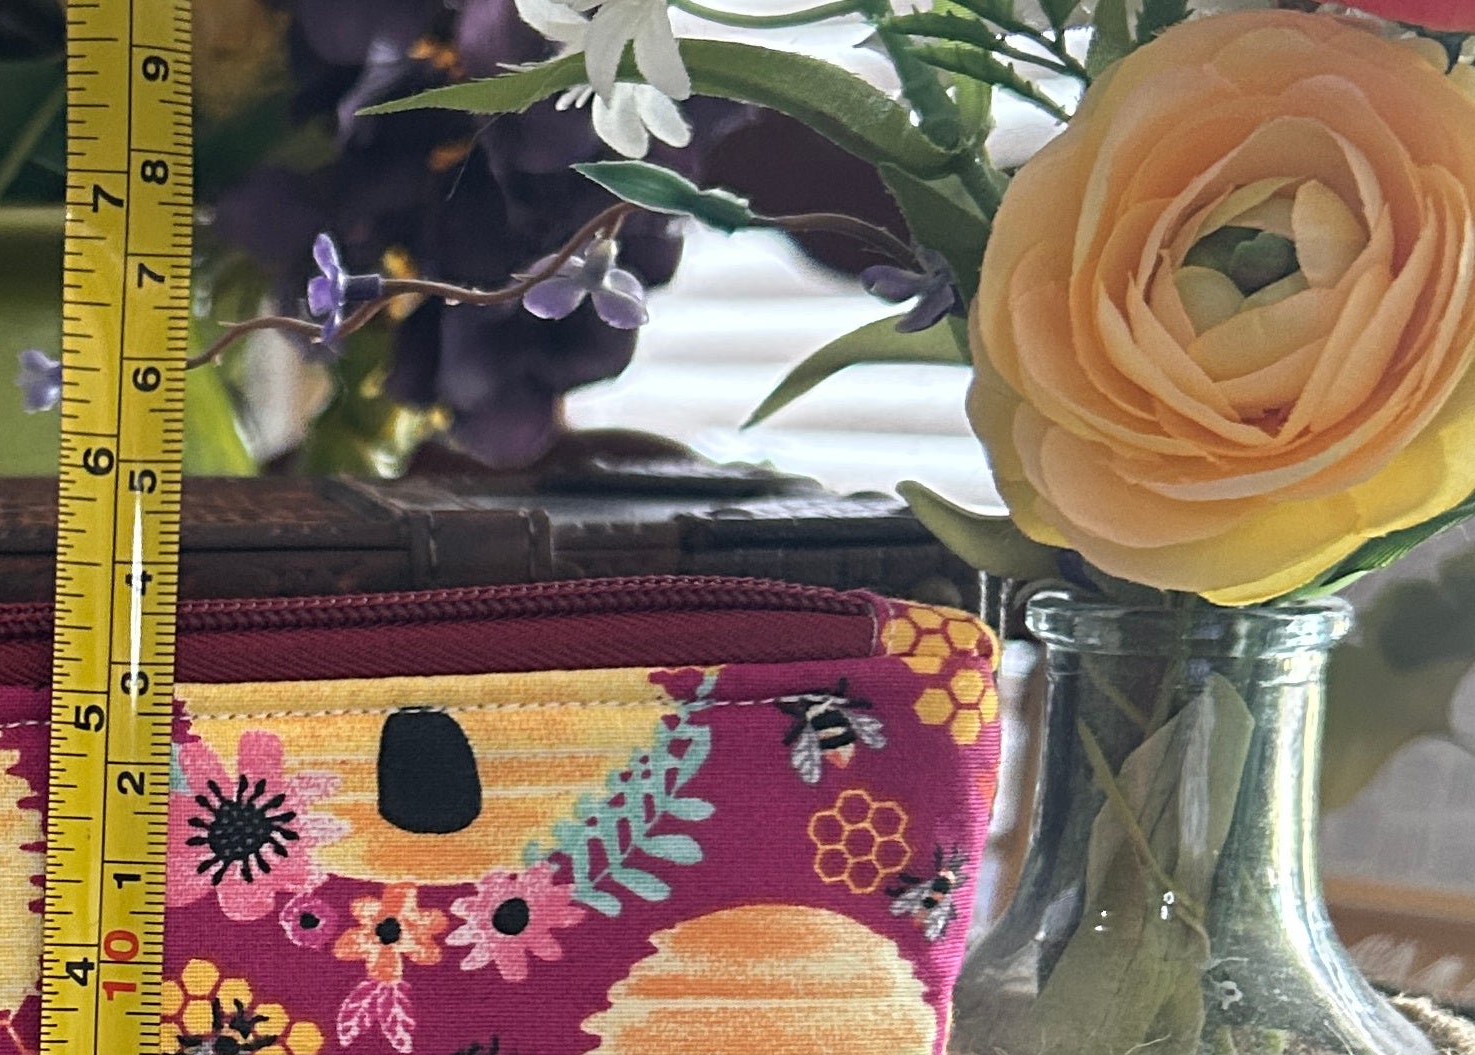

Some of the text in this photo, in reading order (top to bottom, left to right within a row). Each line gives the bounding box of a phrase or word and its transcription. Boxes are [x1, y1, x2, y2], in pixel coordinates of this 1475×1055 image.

[142, 56, 169, 81] 9
[141, 160, 169, 184] 8
[92, 184, 124, 213] 7
[137, 263, 165, 287] 7
[133, 367, 161, 391] 6
[83, 448, 114, 475] 6
[129, 470, 156, 494] 5
[75, 704, 104, 732] 5
[118, 771, 145, 795] 2
[113, 873, 141, 889] 1
[66, 958, 94, 986] 4
[103, 930, 139, 1000] 10
